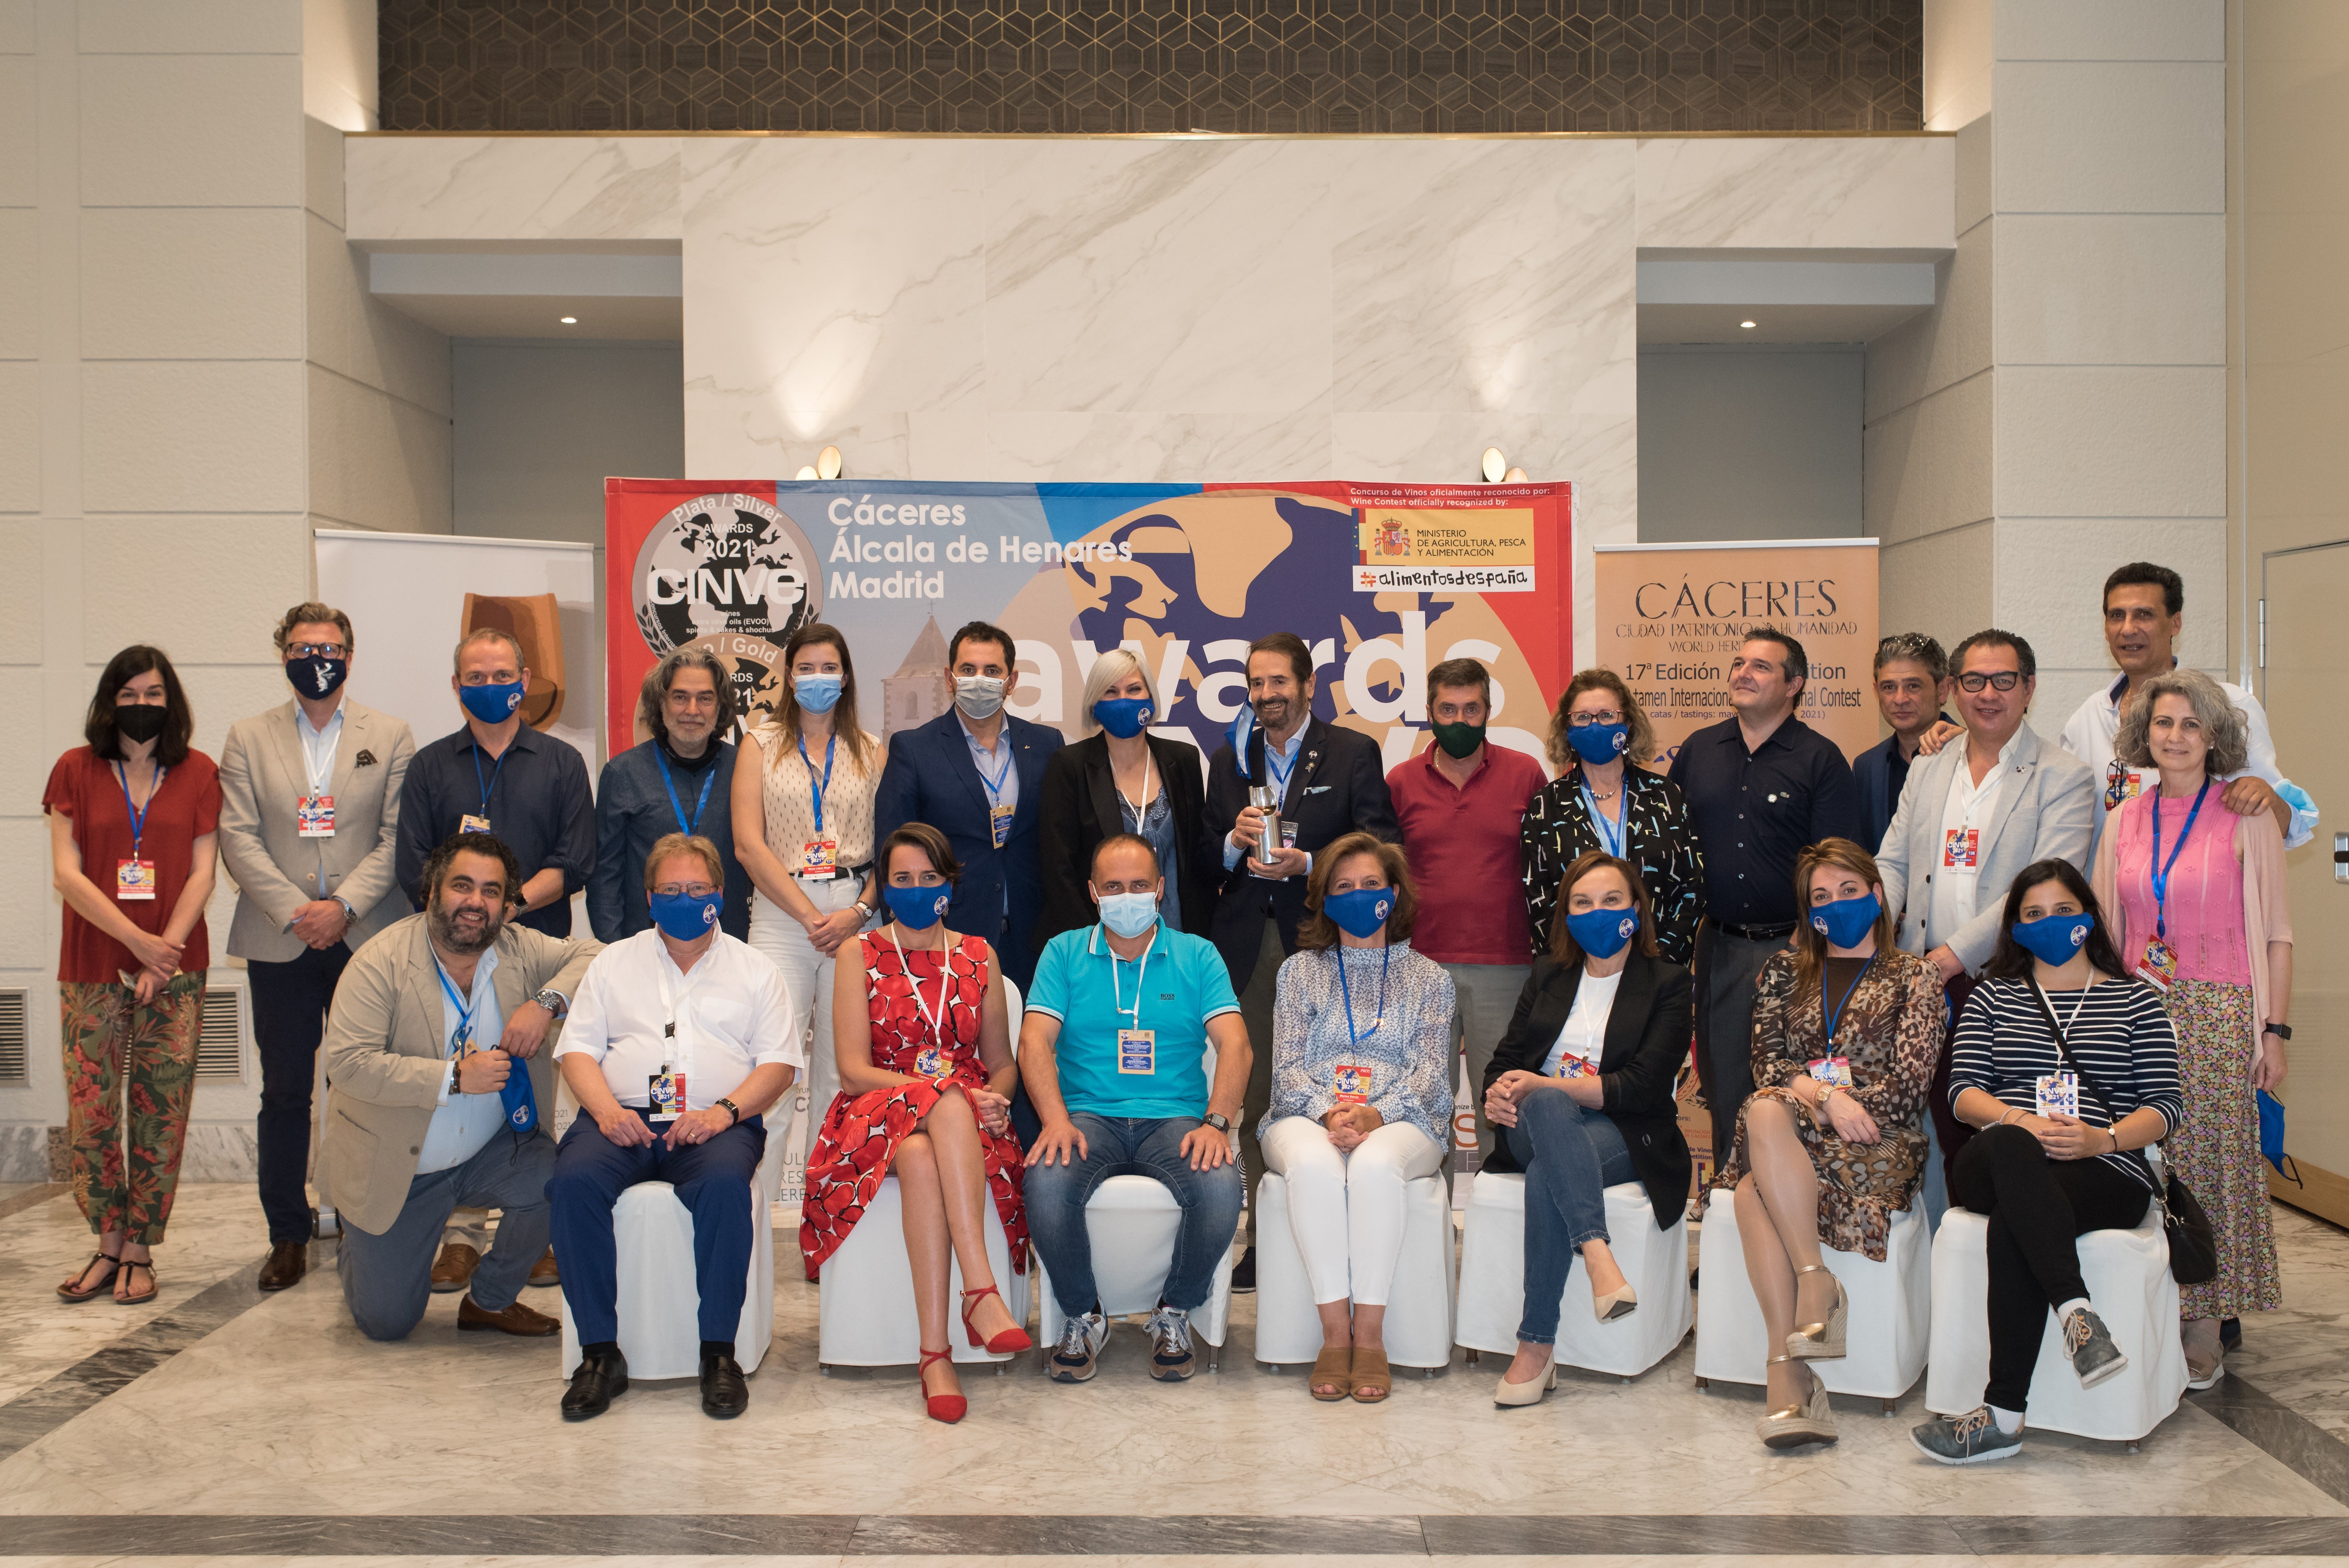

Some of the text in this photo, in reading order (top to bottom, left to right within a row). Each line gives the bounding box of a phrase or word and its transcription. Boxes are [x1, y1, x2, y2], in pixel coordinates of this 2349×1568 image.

[1483, 488, 1531, 496] reconocido
[672, 497, 716, 523] Plata
[733, 493, 783, 522] Silver
[828, 494, 966, 526] Cáceres
[1408, 498, 1445, 507] officially
[1447, 498, 1493, 507] recognized
[1496, 498, 1509, 506] by:
[704, 524, 753, 533] AWARDS
[703, 539, 752, 558] 2021
[829, 527, 1132, 563] Álcala de Henares
[1426, 547, 1494, 556] ALIMENTACIÓN
[1431, 539, 1496, 548] AGRICULTURA,
[829, 570, 944, 599] Madrid
[1361, 569, 1527, 587] #alimentosdespaña
[1636, 573, 1837, 619] CÁCERES
[1616, 624, 1664, 637] CIUDAD
[1671, 623, 1752, 637] PATRIMONIO
[1780, 622, 1857, 635] HUMANIDAD
[732, 637, 778, 664] Gold
[1669, 641, 1713, 653] WORLD
[730, 673, 753, 682] RDS
[1656, 662, 1720, 680] Edición
[1806, 663, 1845, 679] ition
[1633, 688, 1666, 707] tamen
[1820, 688, 1861, 707] Contest
[1681, 710, 1715, 720] tastings:
[1800, 710, 1825, 719] 2021)
